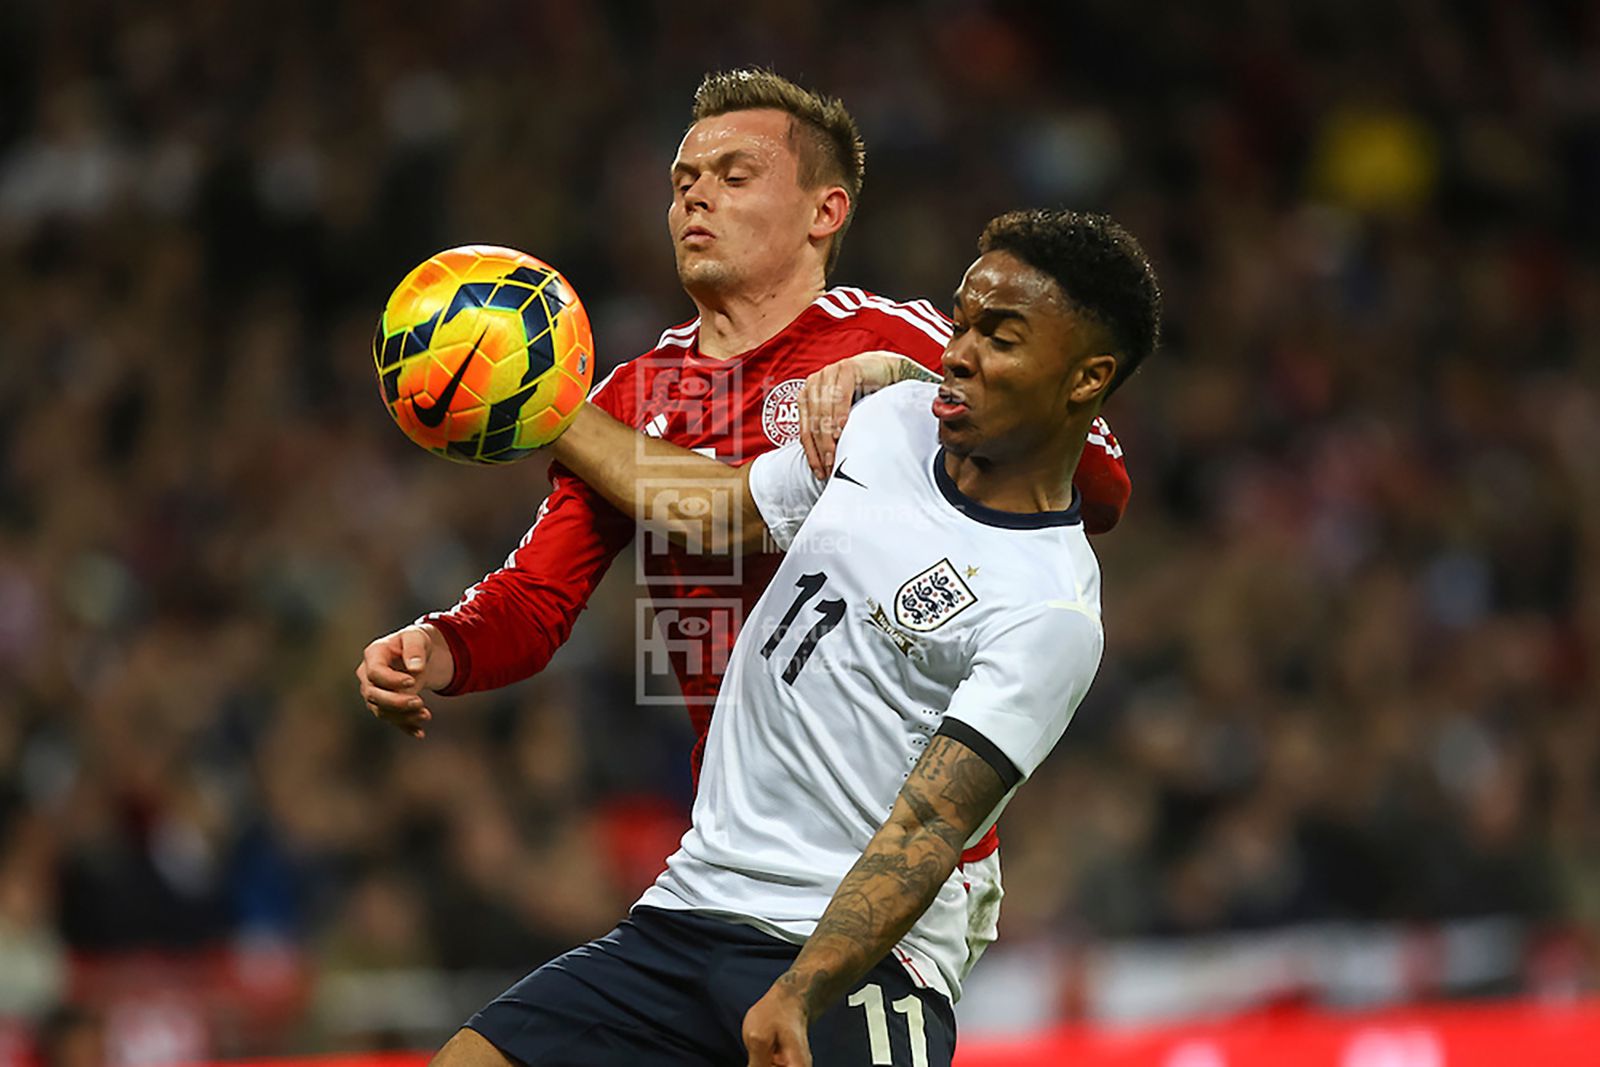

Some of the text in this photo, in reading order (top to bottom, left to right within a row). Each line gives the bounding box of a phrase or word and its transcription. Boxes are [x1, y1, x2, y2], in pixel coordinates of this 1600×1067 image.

[776, 403, 800, 423] DB
[760, 572, 848, 686] 11
[848, 983, 928, 1067] 11
